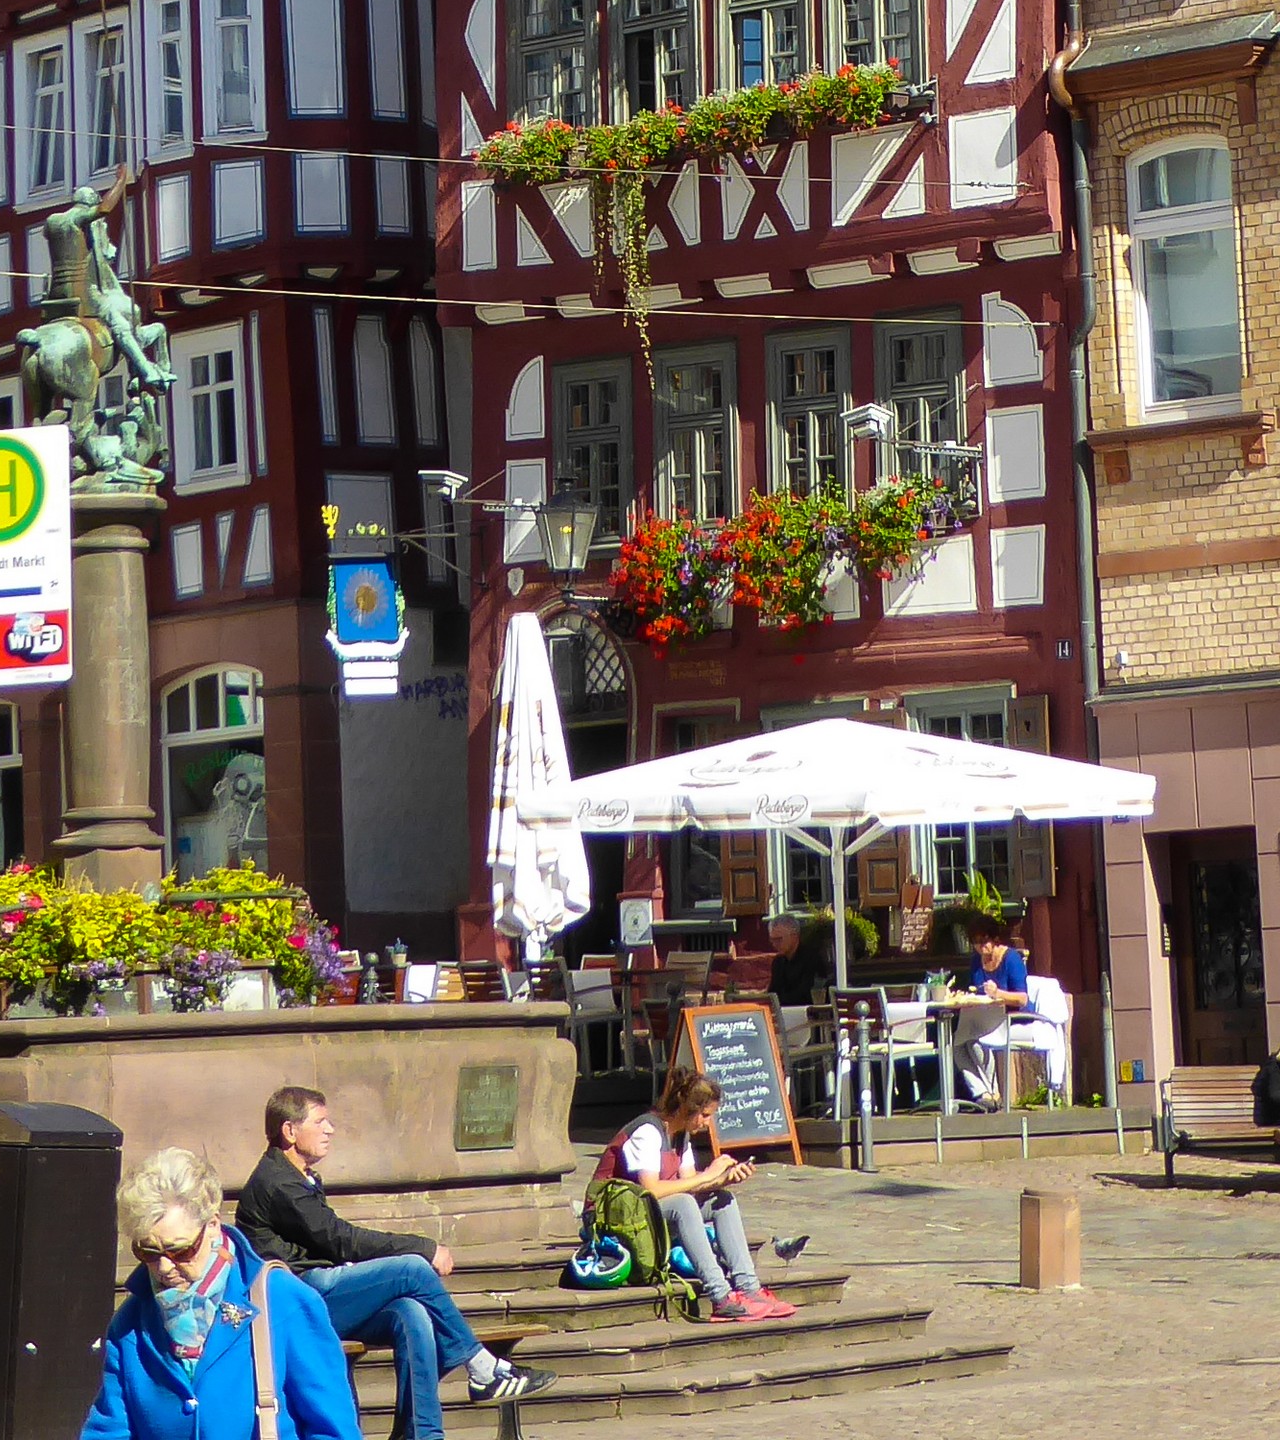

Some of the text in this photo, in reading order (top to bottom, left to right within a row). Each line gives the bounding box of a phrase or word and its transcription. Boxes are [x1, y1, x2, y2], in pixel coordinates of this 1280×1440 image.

[12, 555, 45, 568] Markt
[1058, 641, 1069, 656] 14
[577, 798, 629, 825] Radeberger
[756, 794, 809, 822] Radeberger
